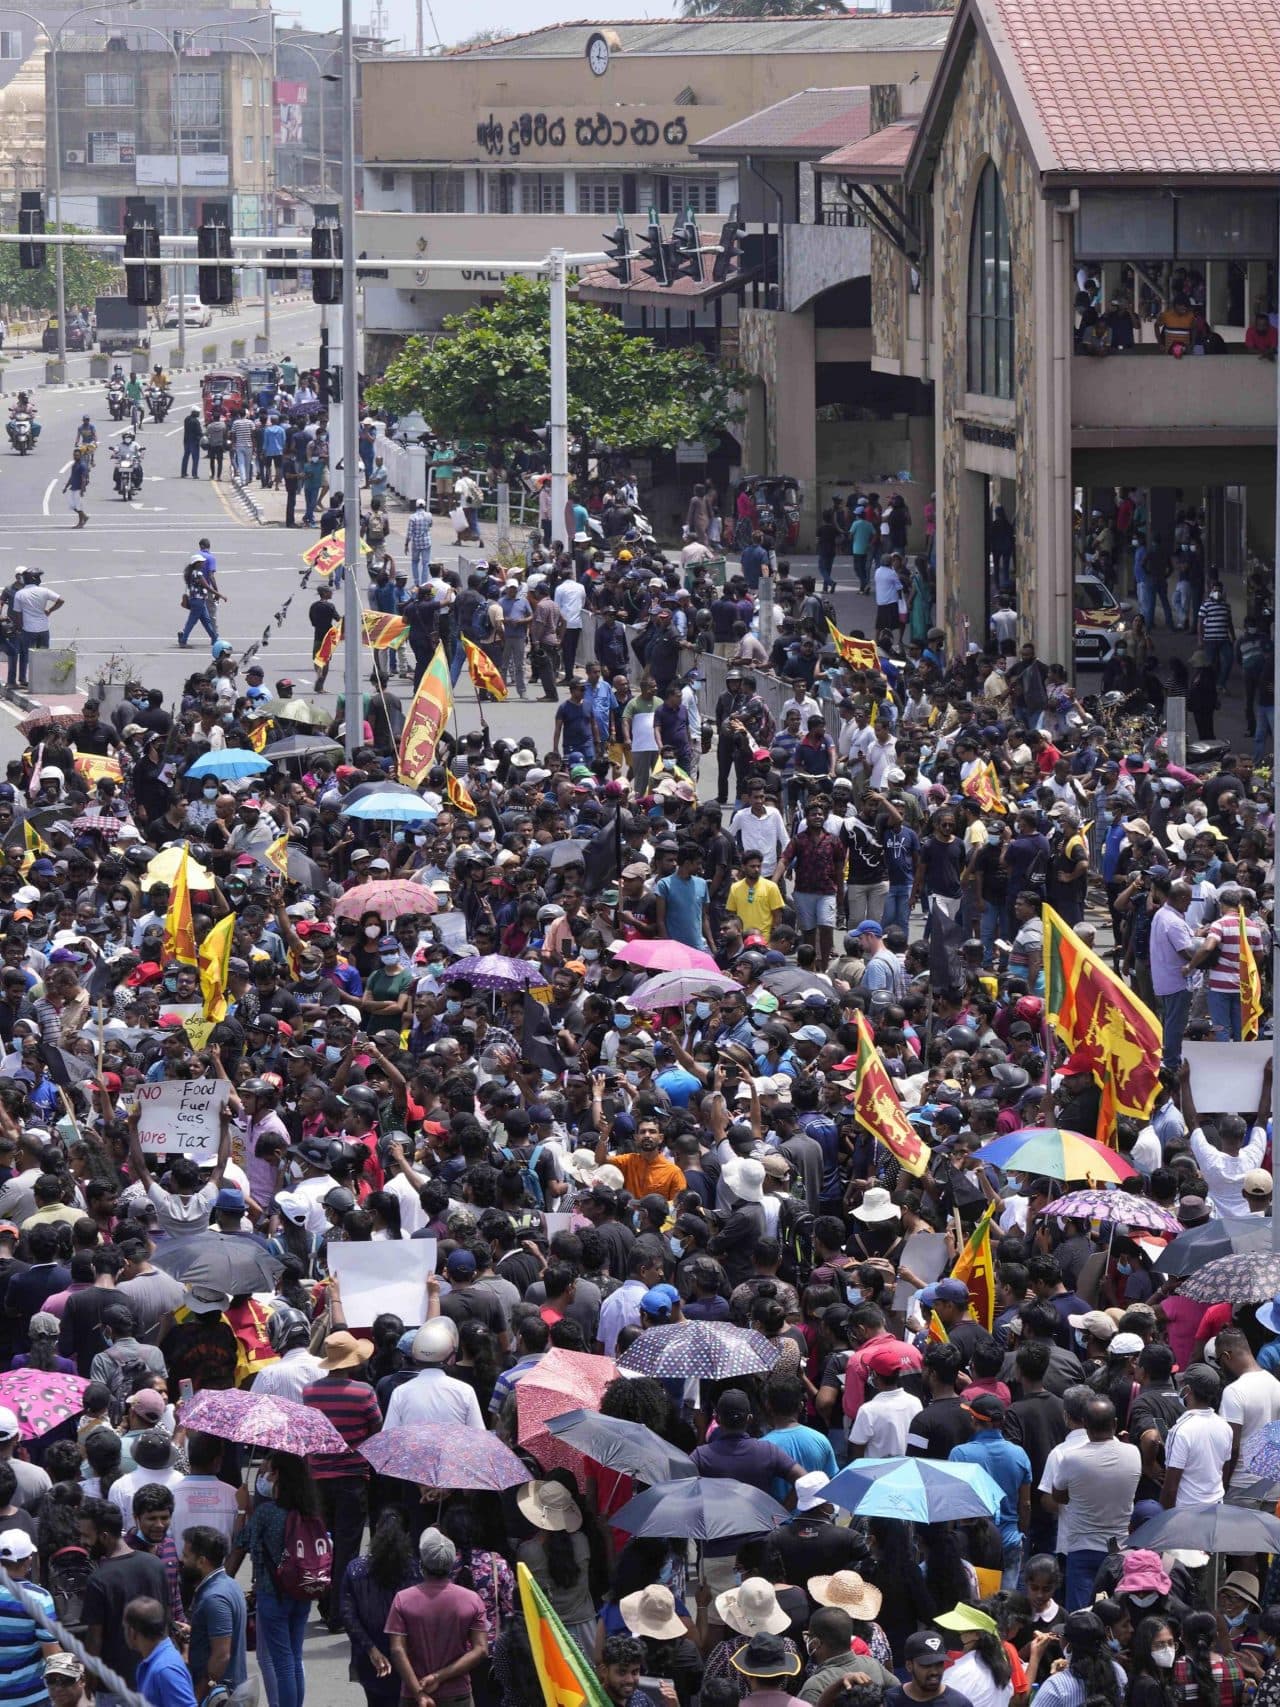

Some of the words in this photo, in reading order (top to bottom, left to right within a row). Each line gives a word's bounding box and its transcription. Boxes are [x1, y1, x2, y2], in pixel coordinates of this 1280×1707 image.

[137, 1086, 162, 1100] NO
[183, 1081, 217, 1096] Food
[180, 1099, 210, 1111] Fuel
[177, 1112, 205, 1124] Gas
[176, 1132, 211, 1148] Tax
